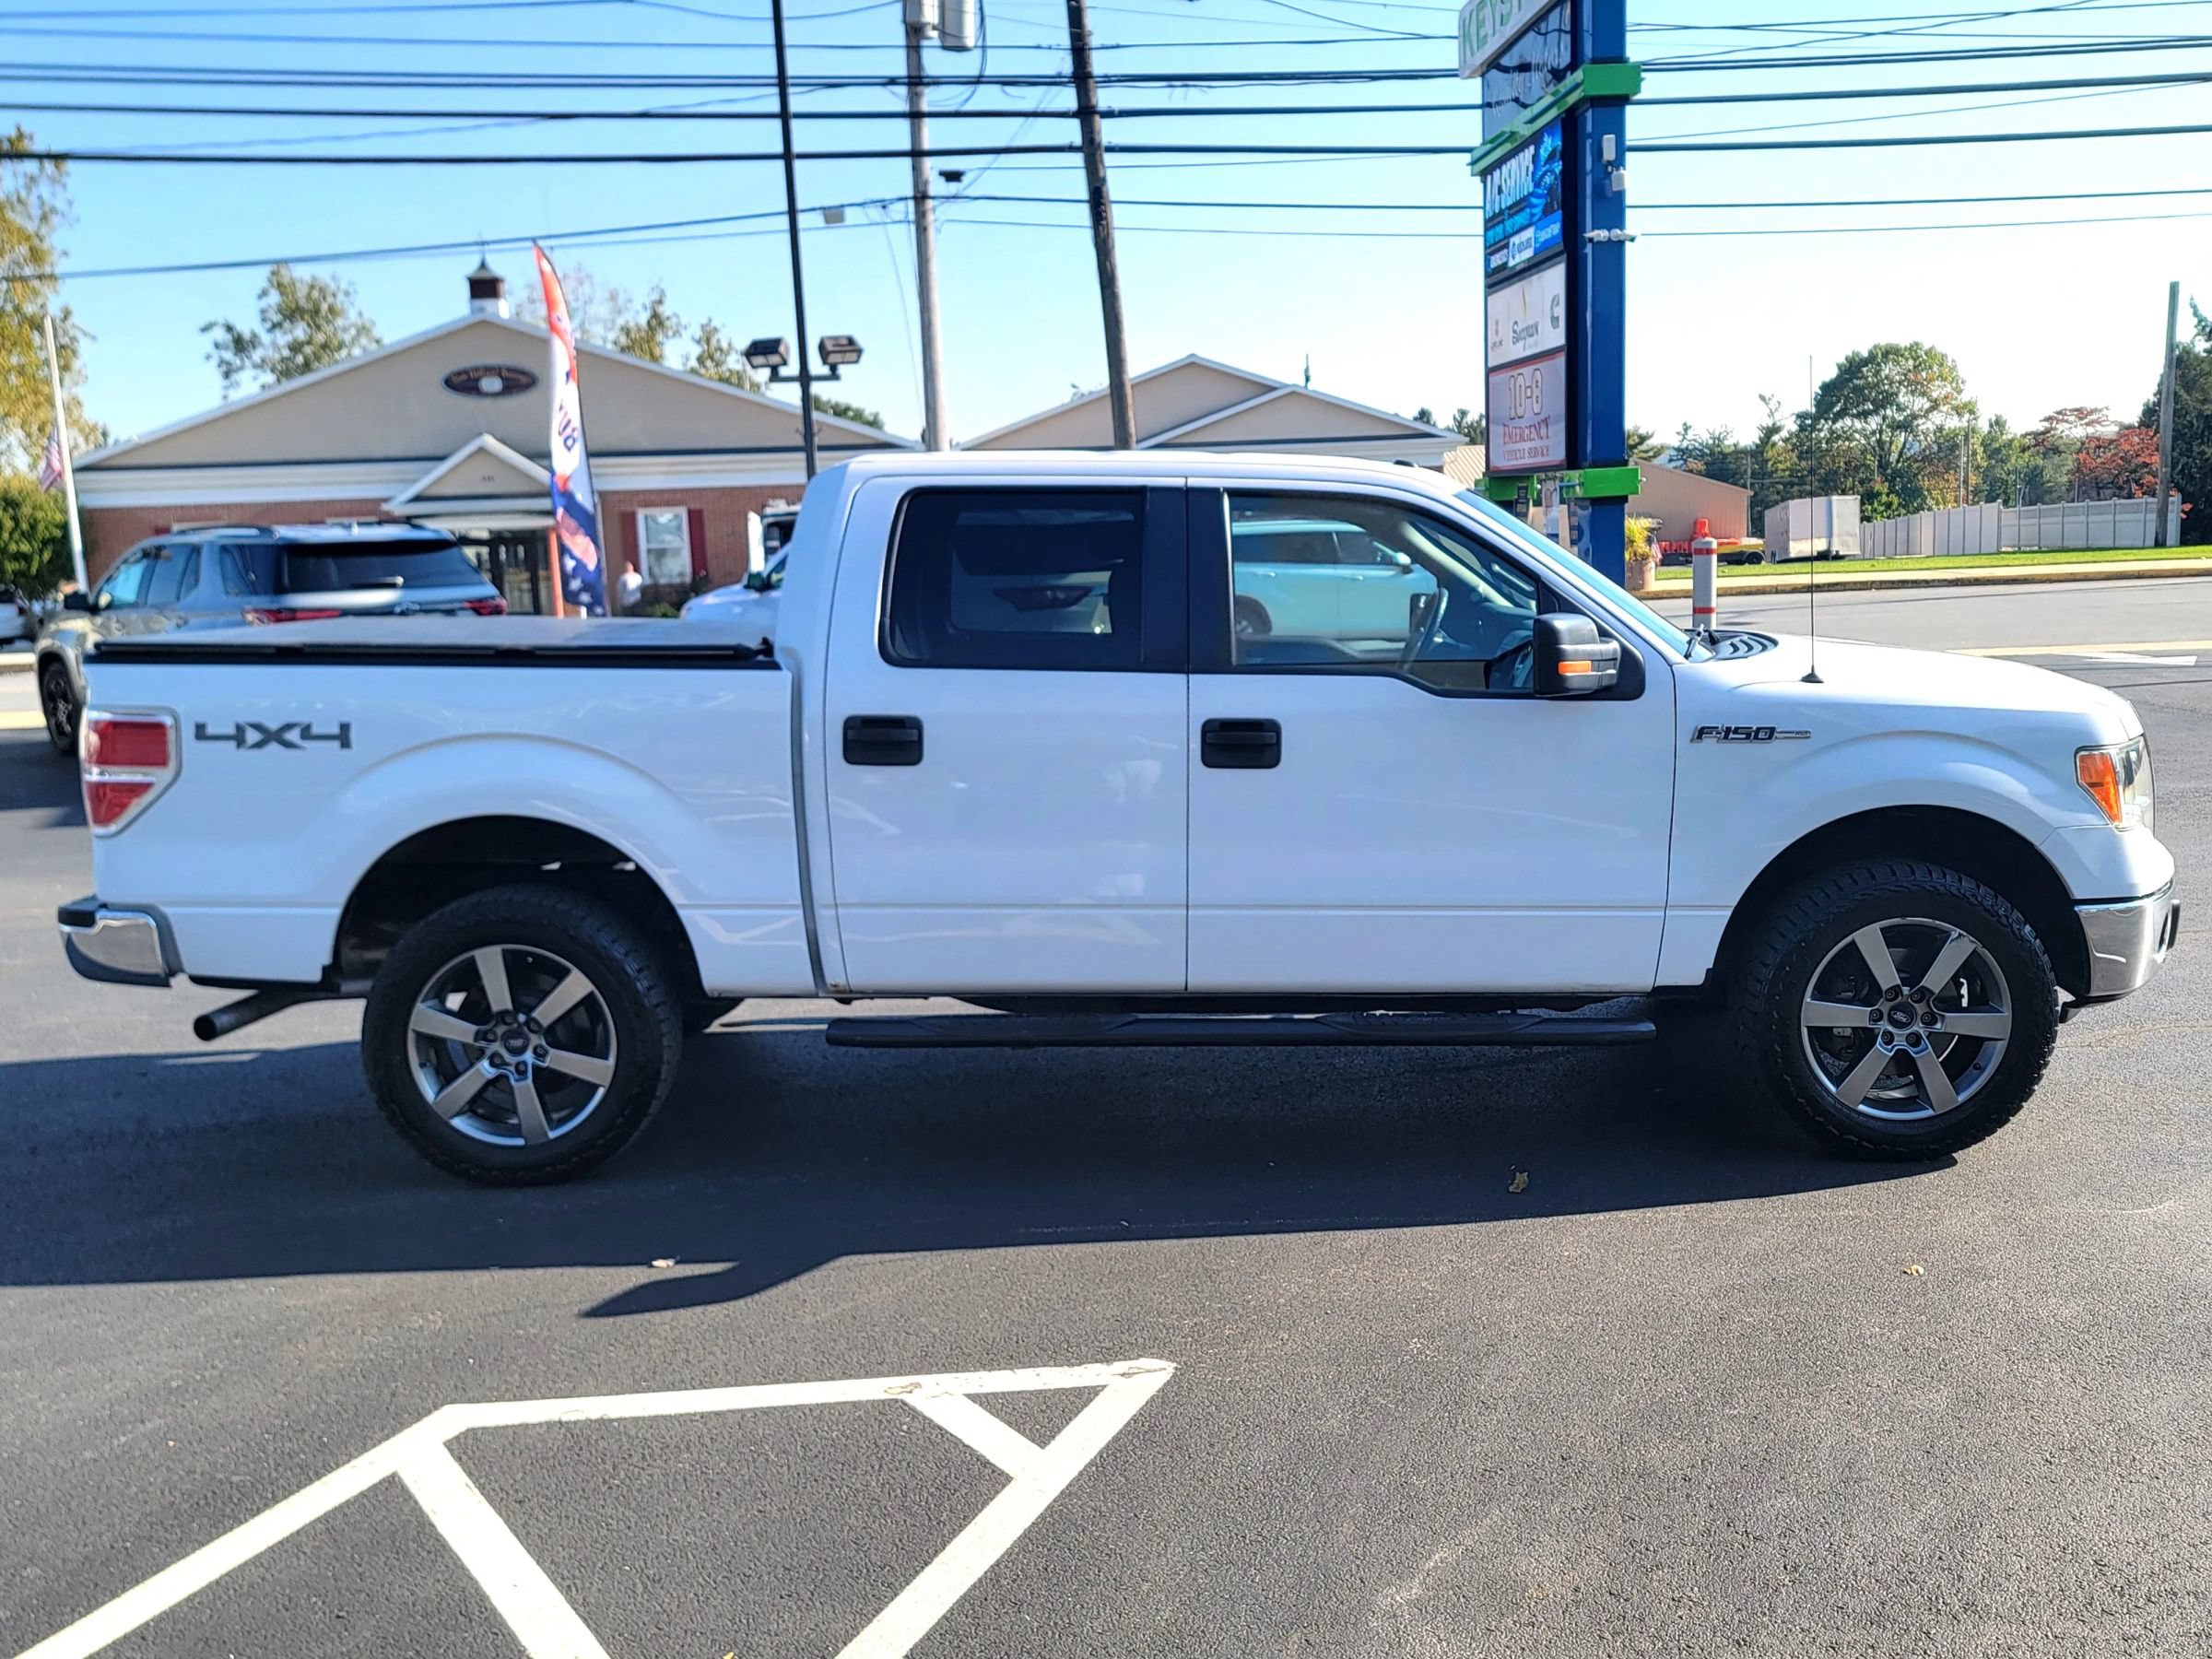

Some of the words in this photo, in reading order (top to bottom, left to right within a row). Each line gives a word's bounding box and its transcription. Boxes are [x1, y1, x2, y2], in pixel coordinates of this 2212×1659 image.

[1462, 0, 1522, 65] KEYS
[1509, 368, 1543, 420] 10-8
[1502, 415, 1550, 445] EMERGENCY
[1503, 448, 1526, 461] VEHICLE
[1527, 444, 1550, 459] SERVICE
[1692, 724, 1777, 743] F-150
